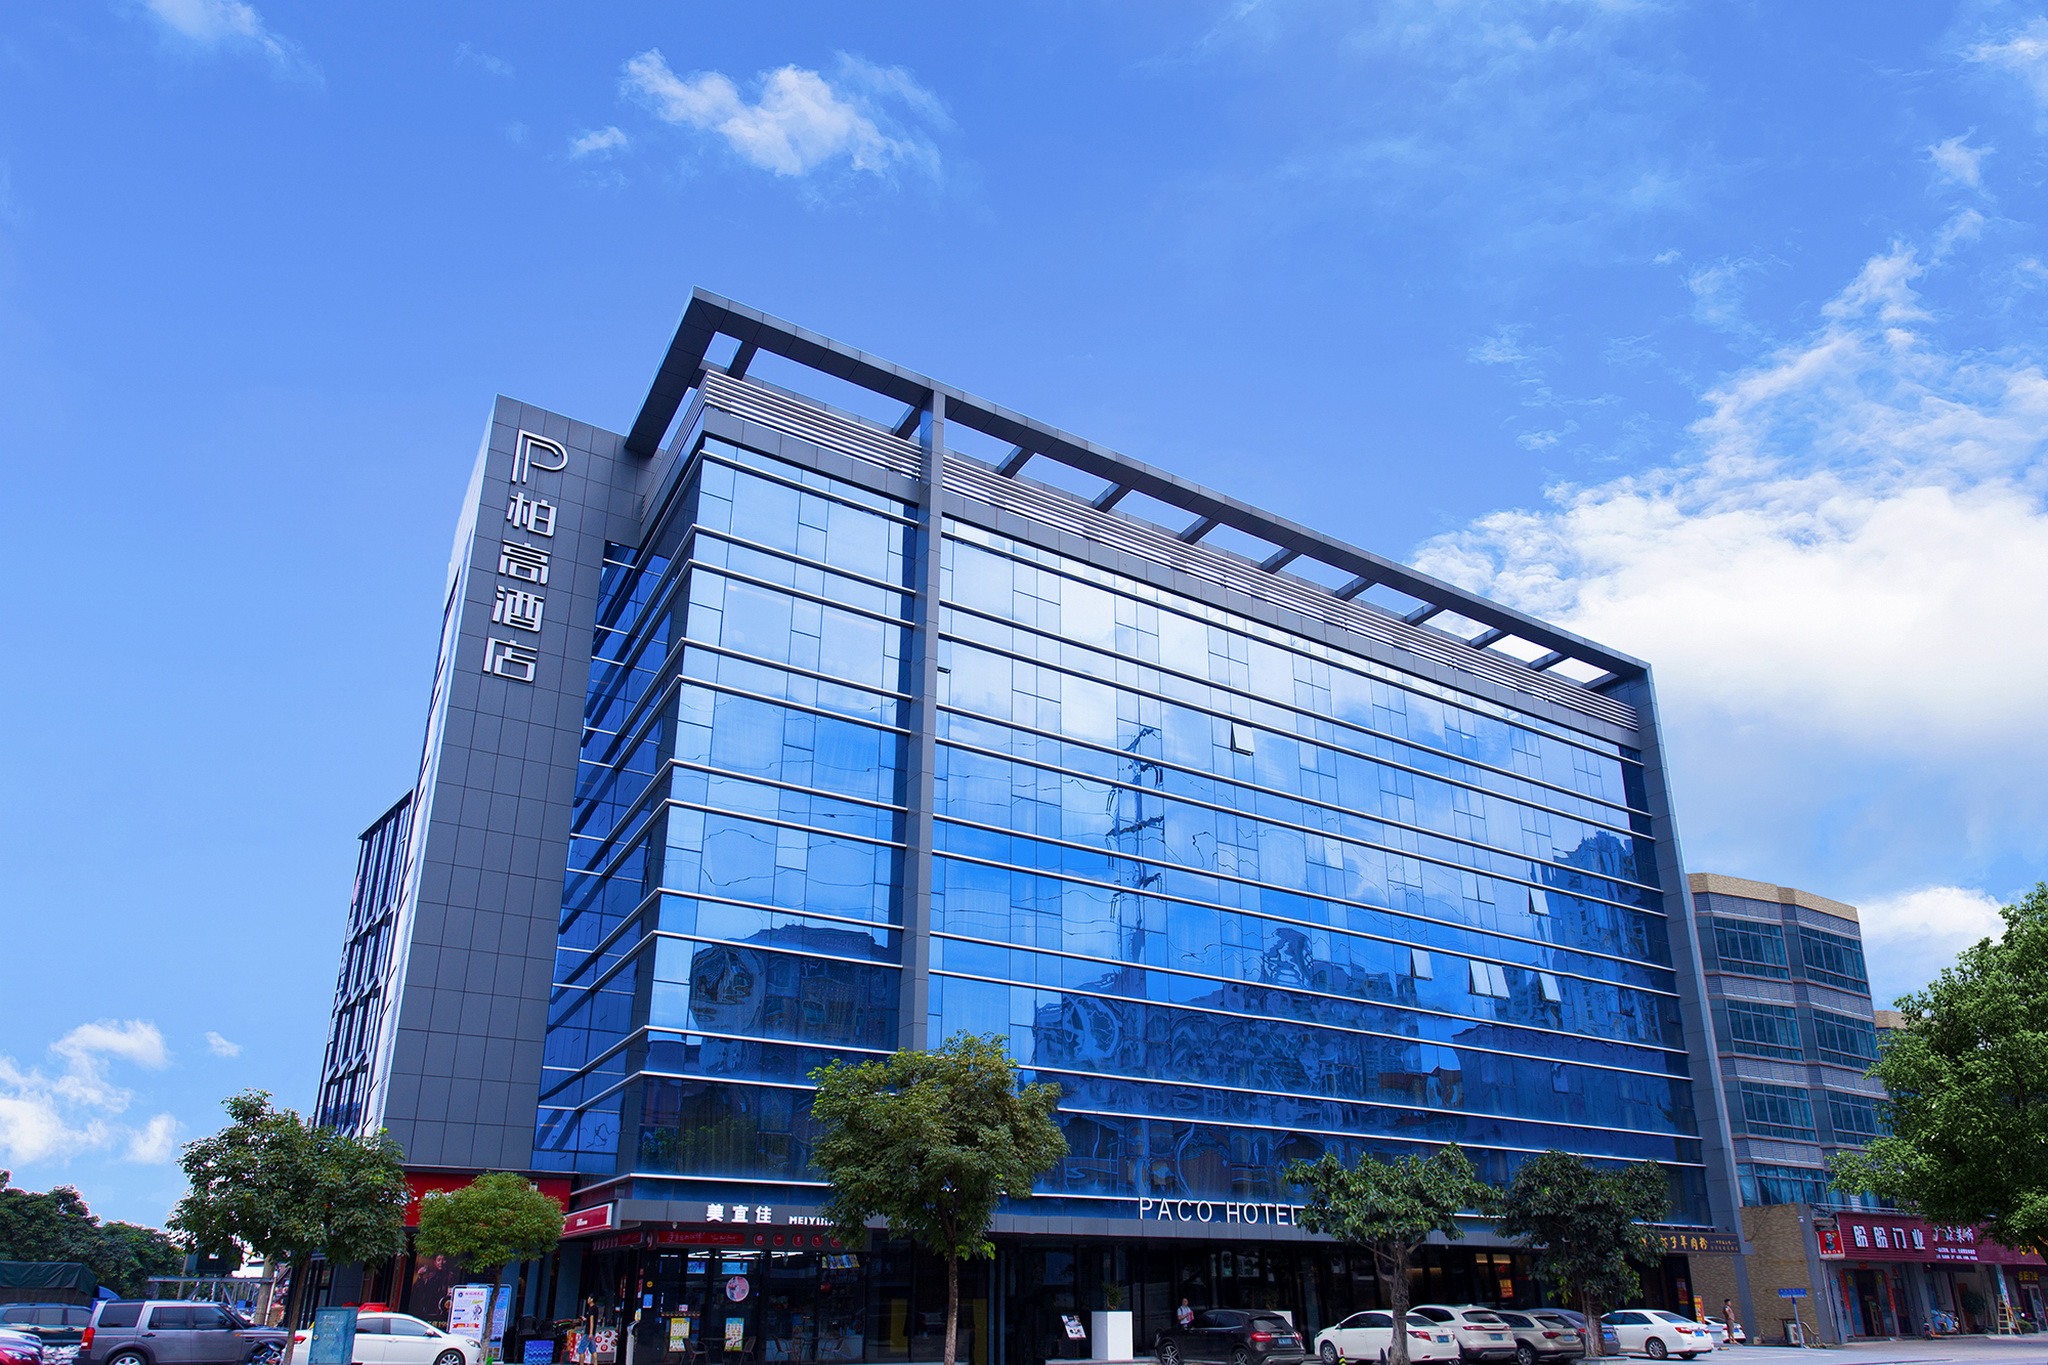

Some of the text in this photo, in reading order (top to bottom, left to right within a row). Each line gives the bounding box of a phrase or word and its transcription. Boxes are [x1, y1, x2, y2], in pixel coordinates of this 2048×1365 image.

[483, 492, 557, 682] 柏高酒店
[706, 1203, 772, 1224] 美宜佳
[1139, 1197, 1298, 1226] PACO HOTEL
[1852, 1225, 1926, 1250] 盼盼门业
